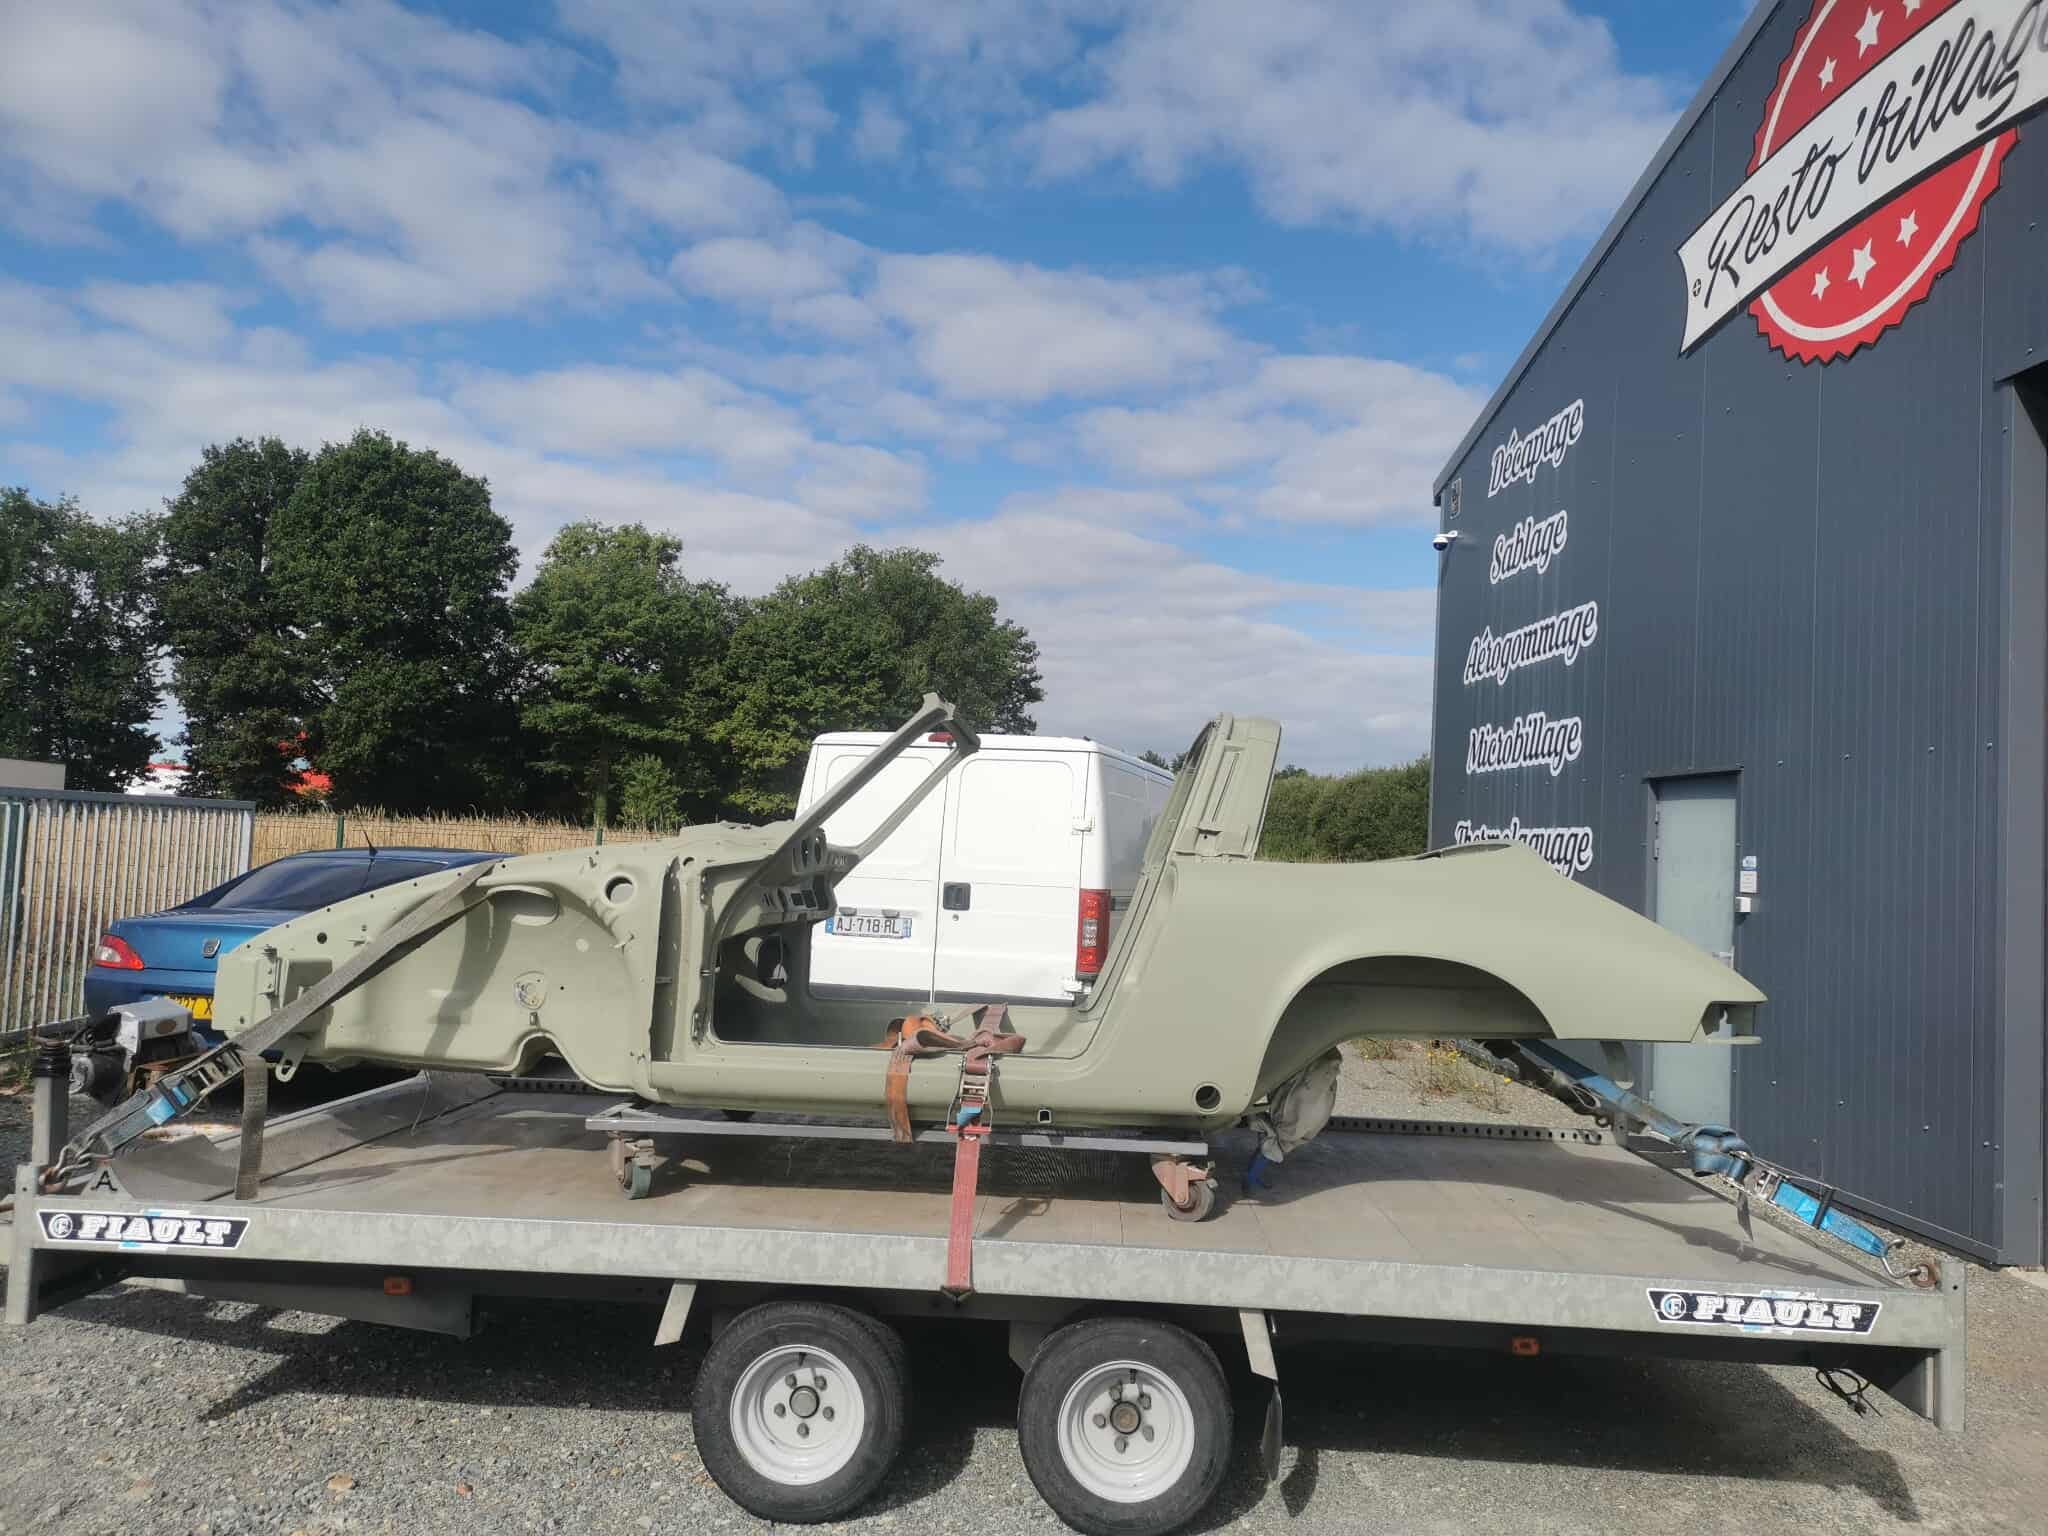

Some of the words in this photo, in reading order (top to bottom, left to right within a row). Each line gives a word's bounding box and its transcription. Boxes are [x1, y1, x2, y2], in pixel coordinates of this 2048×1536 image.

[1489, 400, 1583, 495] Décapage
[1491, 512, 1567, 583] Sablage
[1465, 604, 1596, 684] Aérogommage
[1468, 711, 1581, 773] Microbillage
[78, 1214, 231, 1244] FIAULT
[1694, 1295, 1861, 1328] FIAULT
